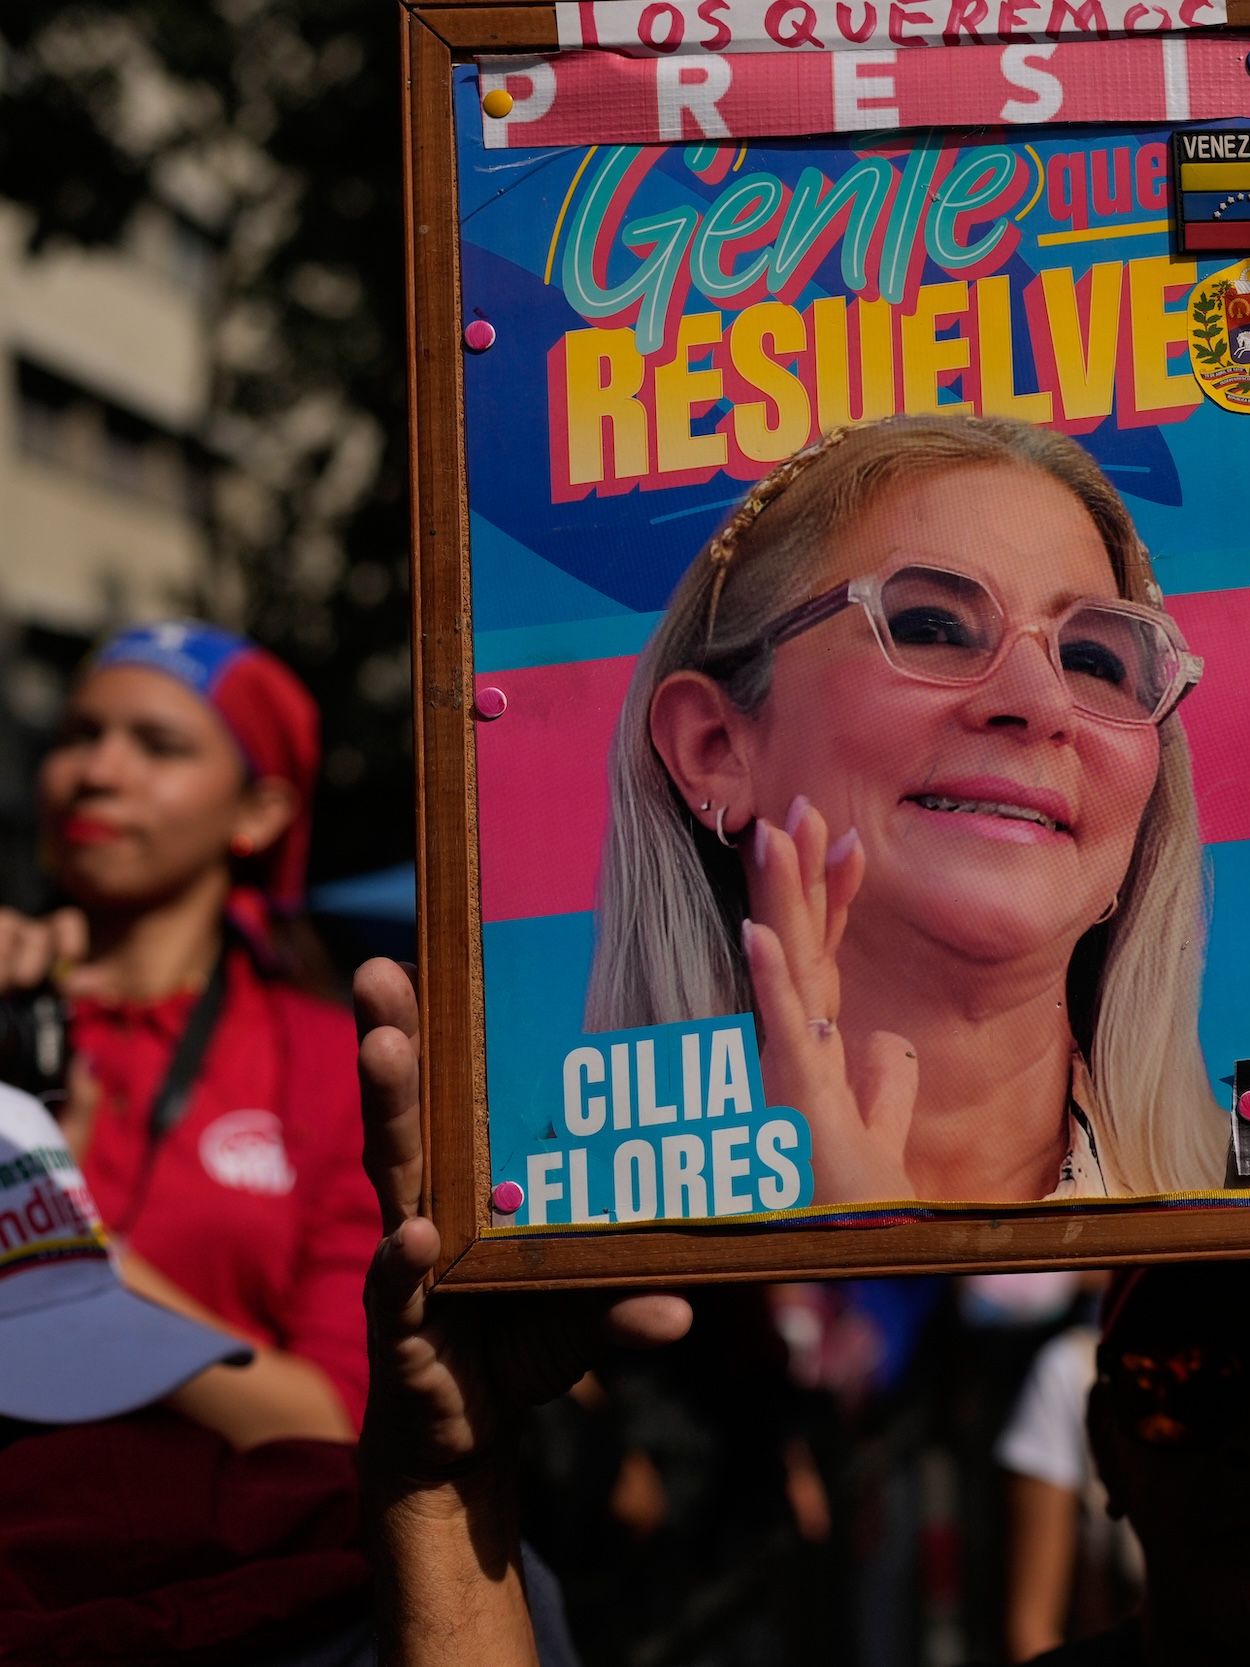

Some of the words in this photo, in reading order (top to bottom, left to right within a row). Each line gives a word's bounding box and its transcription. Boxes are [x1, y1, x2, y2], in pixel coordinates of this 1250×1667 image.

[578, 0, 732, 55] LOS
[562, 128, 1024, 355] Gente
[1047, 142, 1170, 231] que
[550, 257, 1205, 494] RESUELVE
[562, 1027, 752, 1137] CILIA
[526, 1119, 801, 1226] FLORES
